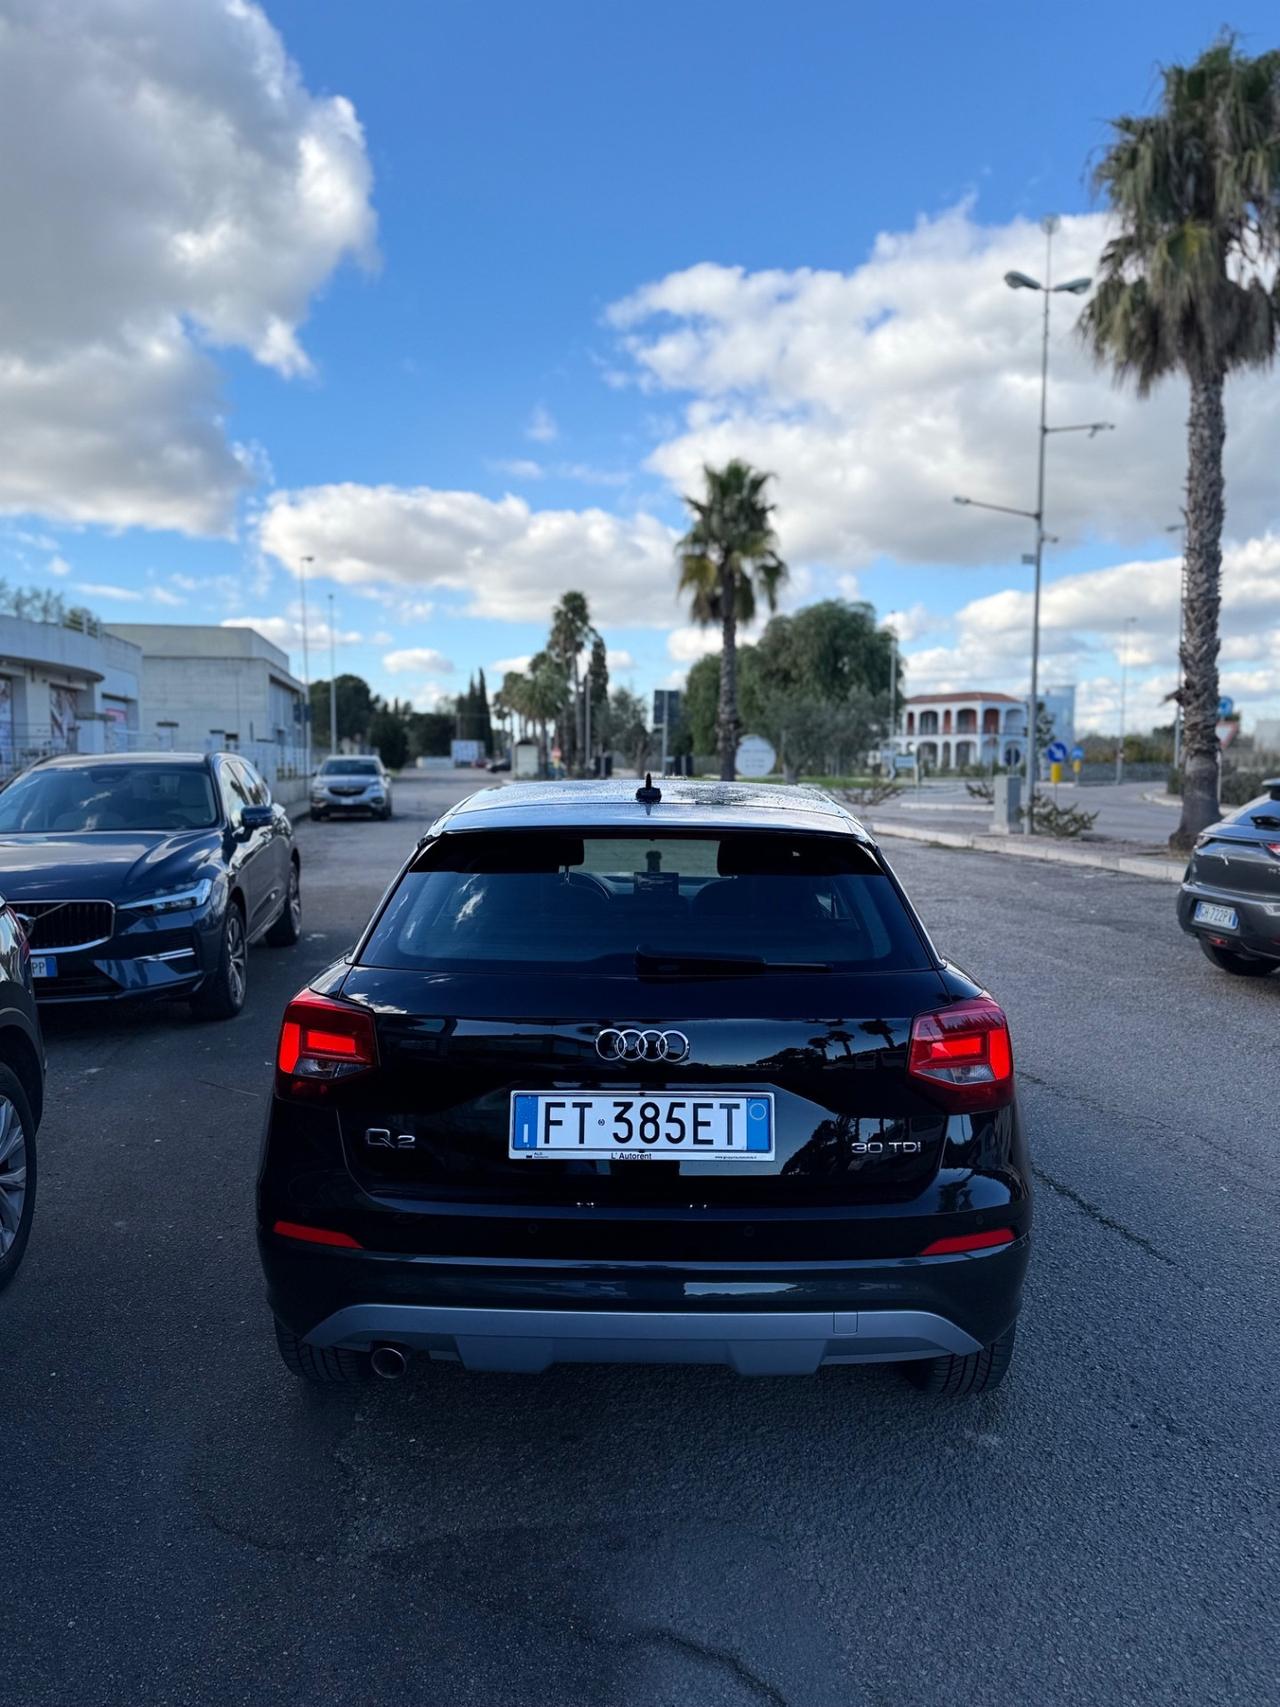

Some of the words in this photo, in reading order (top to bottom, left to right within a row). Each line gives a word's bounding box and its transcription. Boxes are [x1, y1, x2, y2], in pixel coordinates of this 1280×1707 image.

[544, 1101, 593, 1144] FT
[612, 1101, 741, 1146] 385ET
[366, 1128, 416, 1149] Q2
[619, 1152, 652, 1160] Autorent
[851, 1142, 883, 1154] 30
[888, 1141, 921, 1153] TDI
